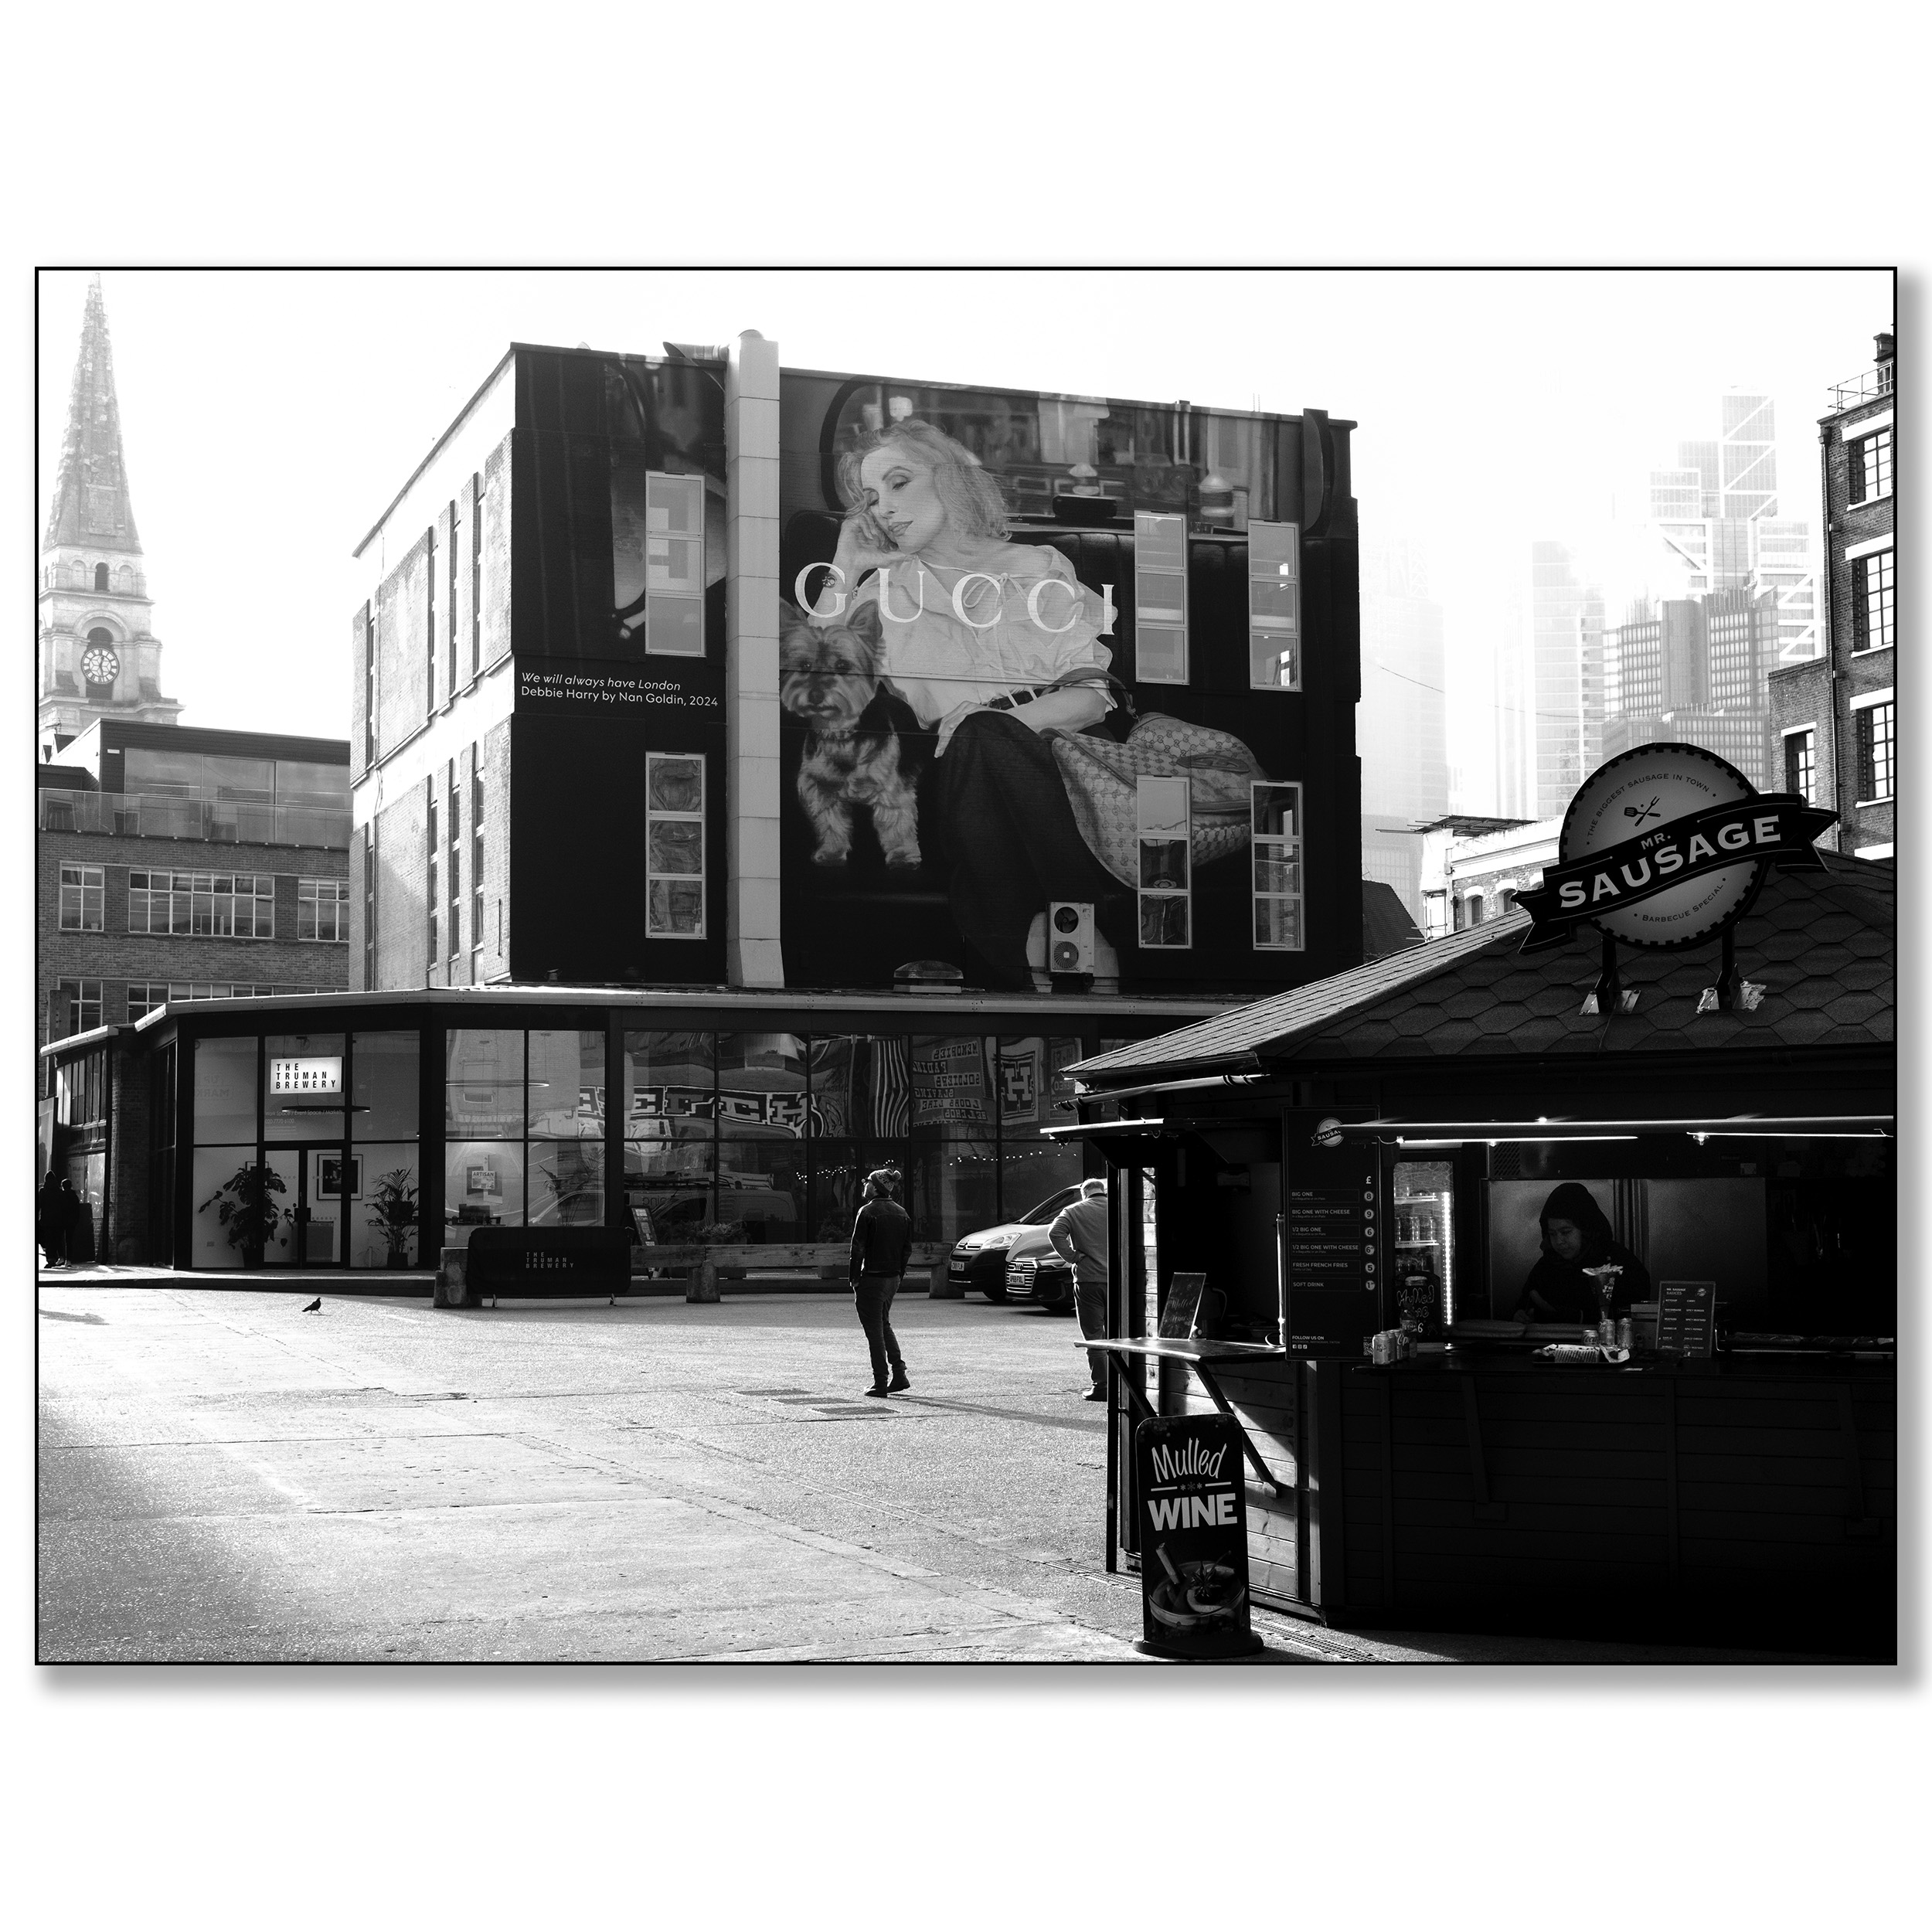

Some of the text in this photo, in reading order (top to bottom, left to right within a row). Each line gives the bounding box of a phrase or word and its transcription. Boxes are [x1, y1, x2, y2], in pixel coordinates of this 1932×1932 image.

[794, 562, 1114, 635] GUCCI
[522, 672, 681, 691] We will always have London
[522, 686, 719, 706] Debbie Harry by Nan Goldin, 2024
[1588, 820, 1598, 836] THE
[1596, 785, 1625, 817] BIGGEST
[1628, 773, 1669, 788] SAUSAGE
[1685, 777, 1709, 792] TOWN
[1641, 832, 1672, 850] MR.
[1558, 815, 1781, 908] SAUSAGE
[276, 1063, 299, 1071] THE
[276, 1071, 327, 1080] TRUMAN
[276, 1080, 336, 1090] BREWERY
[1366, 1175, 1372, 1185] £
[1396, 1284, 1434, 1307] Mulled
[1151, 1437, 1227, 1483] Mulled
[1147, 1492, 1239, 1531] WINE
